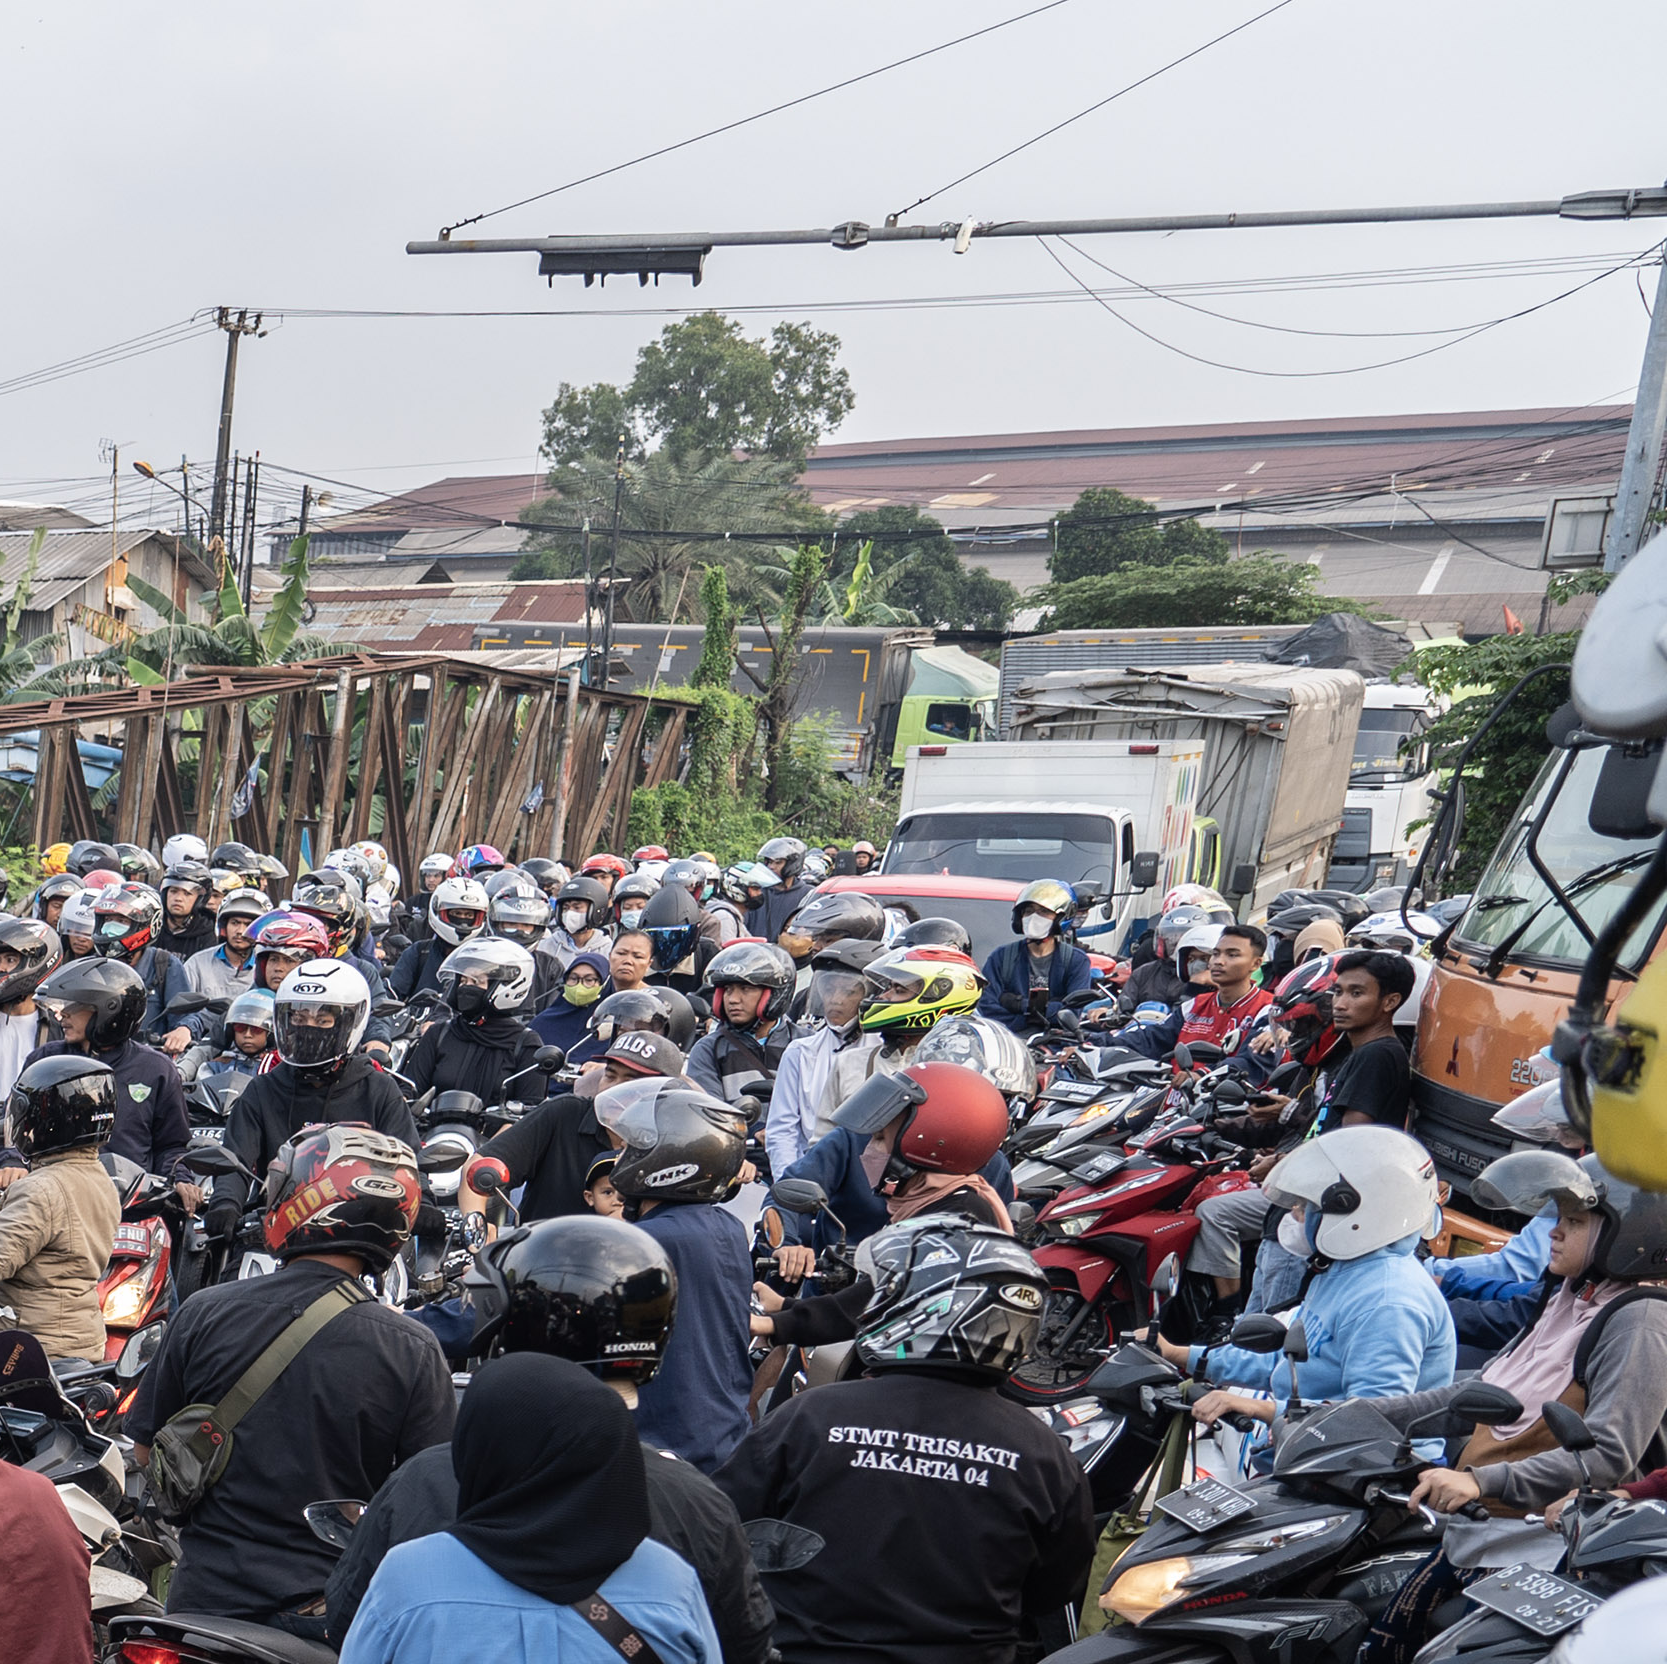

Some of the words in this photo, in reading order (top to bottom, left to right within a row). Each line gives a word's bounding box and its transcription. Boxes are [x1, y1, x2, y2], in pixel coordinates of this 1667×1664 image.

[614, 1035, 657, 1059] BLDS
[1458, 1152, 1487, 1173] FUSO
[363, 1179, 398, 1195] G2
[650, 1166, 692, 1184] INK
[284, 1176, 339, 1228] RIDE
[603, 1341, 657, 1354] HONDA
[828, 1426, 899, 1449] STMT
[901, 1432, 1021, 1472] TRISAKTI
[849, 1449, 961, 1482] JAKARTA
[963, 1466, 990, 1488] 04
[1182, 1591, 1249, 1611] HONDA
[1497, 1565, 1523, 1580] B
[1514, 1574, 1565, 1601] 5998
[1554, 1593, 1600, 1619] FIS
[1269, 1617, 1334, 1650] FI
